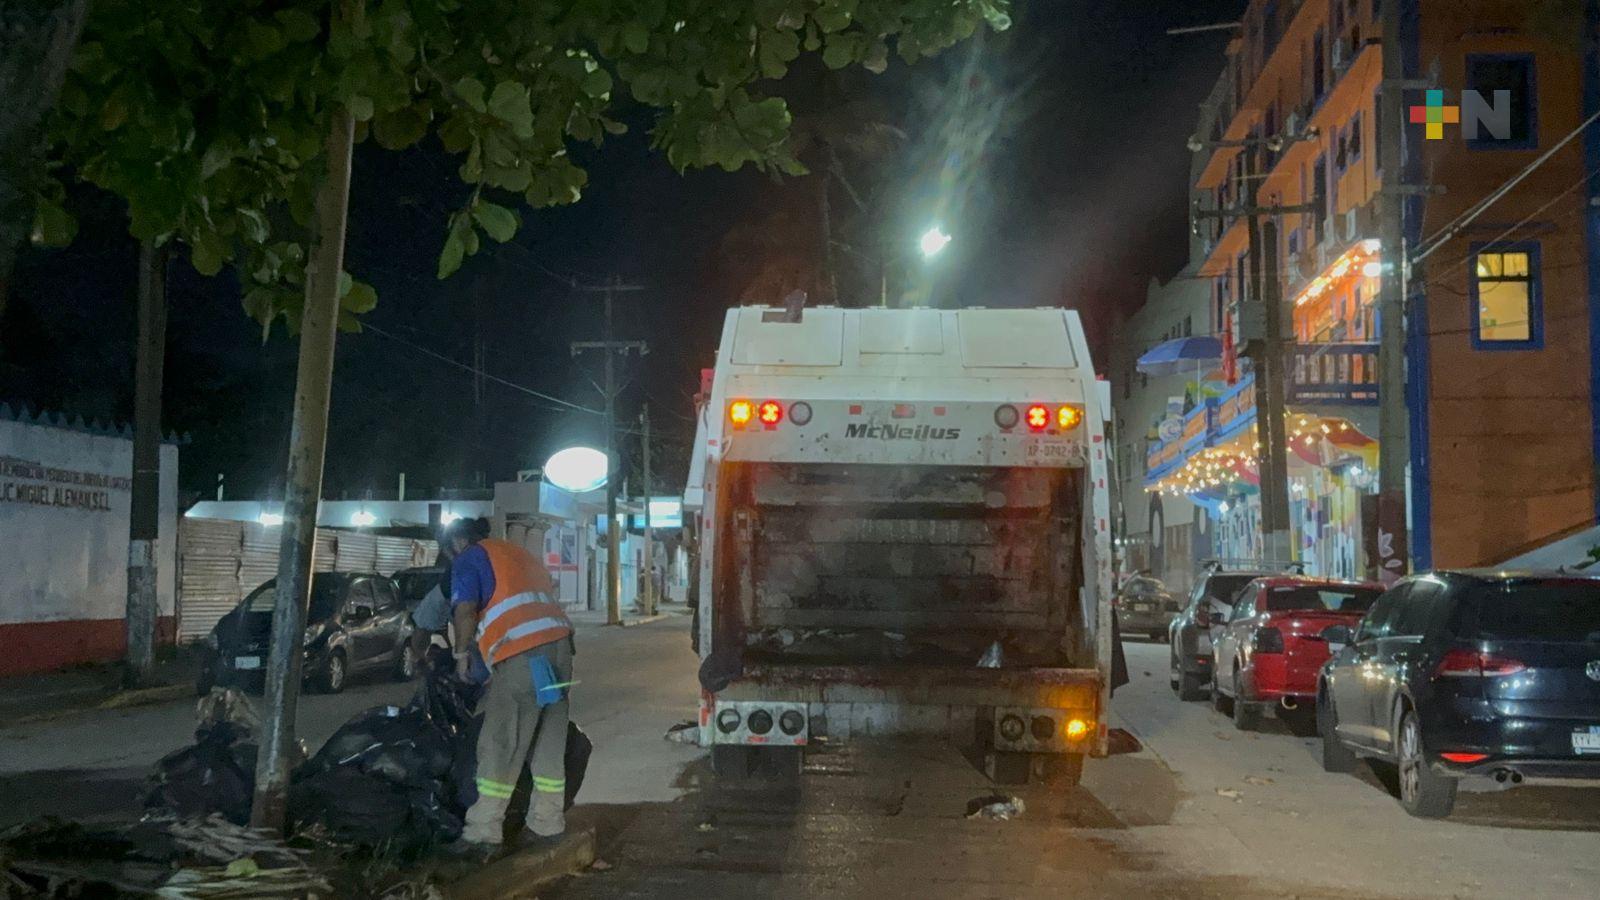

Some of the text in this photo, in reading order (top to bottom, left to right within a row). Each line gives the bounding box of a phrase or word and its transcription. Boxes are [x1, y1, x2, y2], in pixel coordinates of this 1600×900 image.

[845, 423, 961, 441] McNeilus
[15, 483, 51, 506] MIGUEL
[52, 486, 91, 509] ALEMAN
